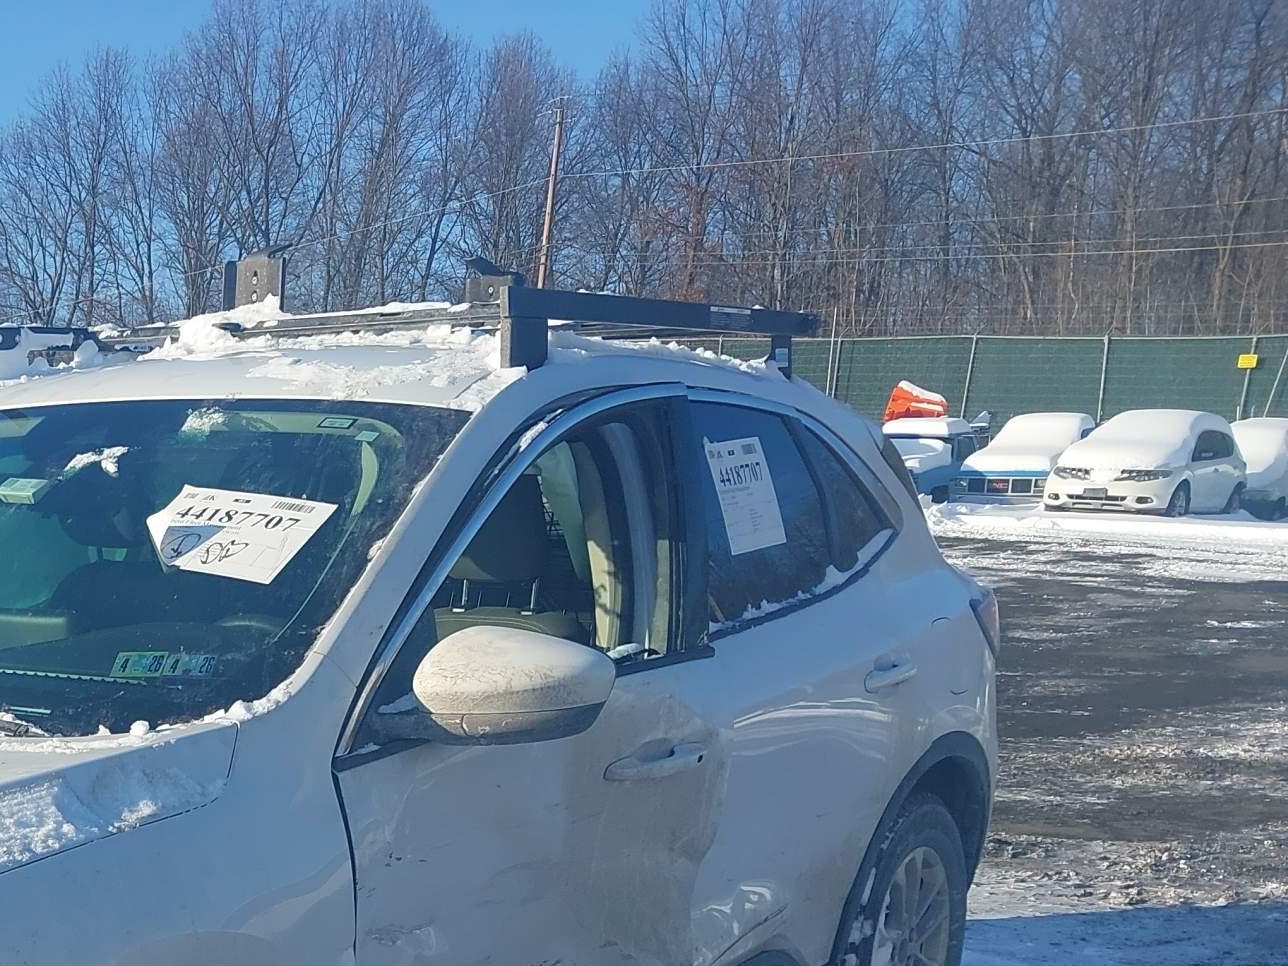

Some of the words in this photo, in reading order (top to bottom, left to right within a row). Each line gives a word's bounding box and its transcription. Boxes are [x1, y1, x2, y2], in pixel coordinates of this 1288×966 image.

[719, 461, 763, 487] 44187707
[175, 505, 301, 532] 44187707
[198, 656, 216, 674] 26
